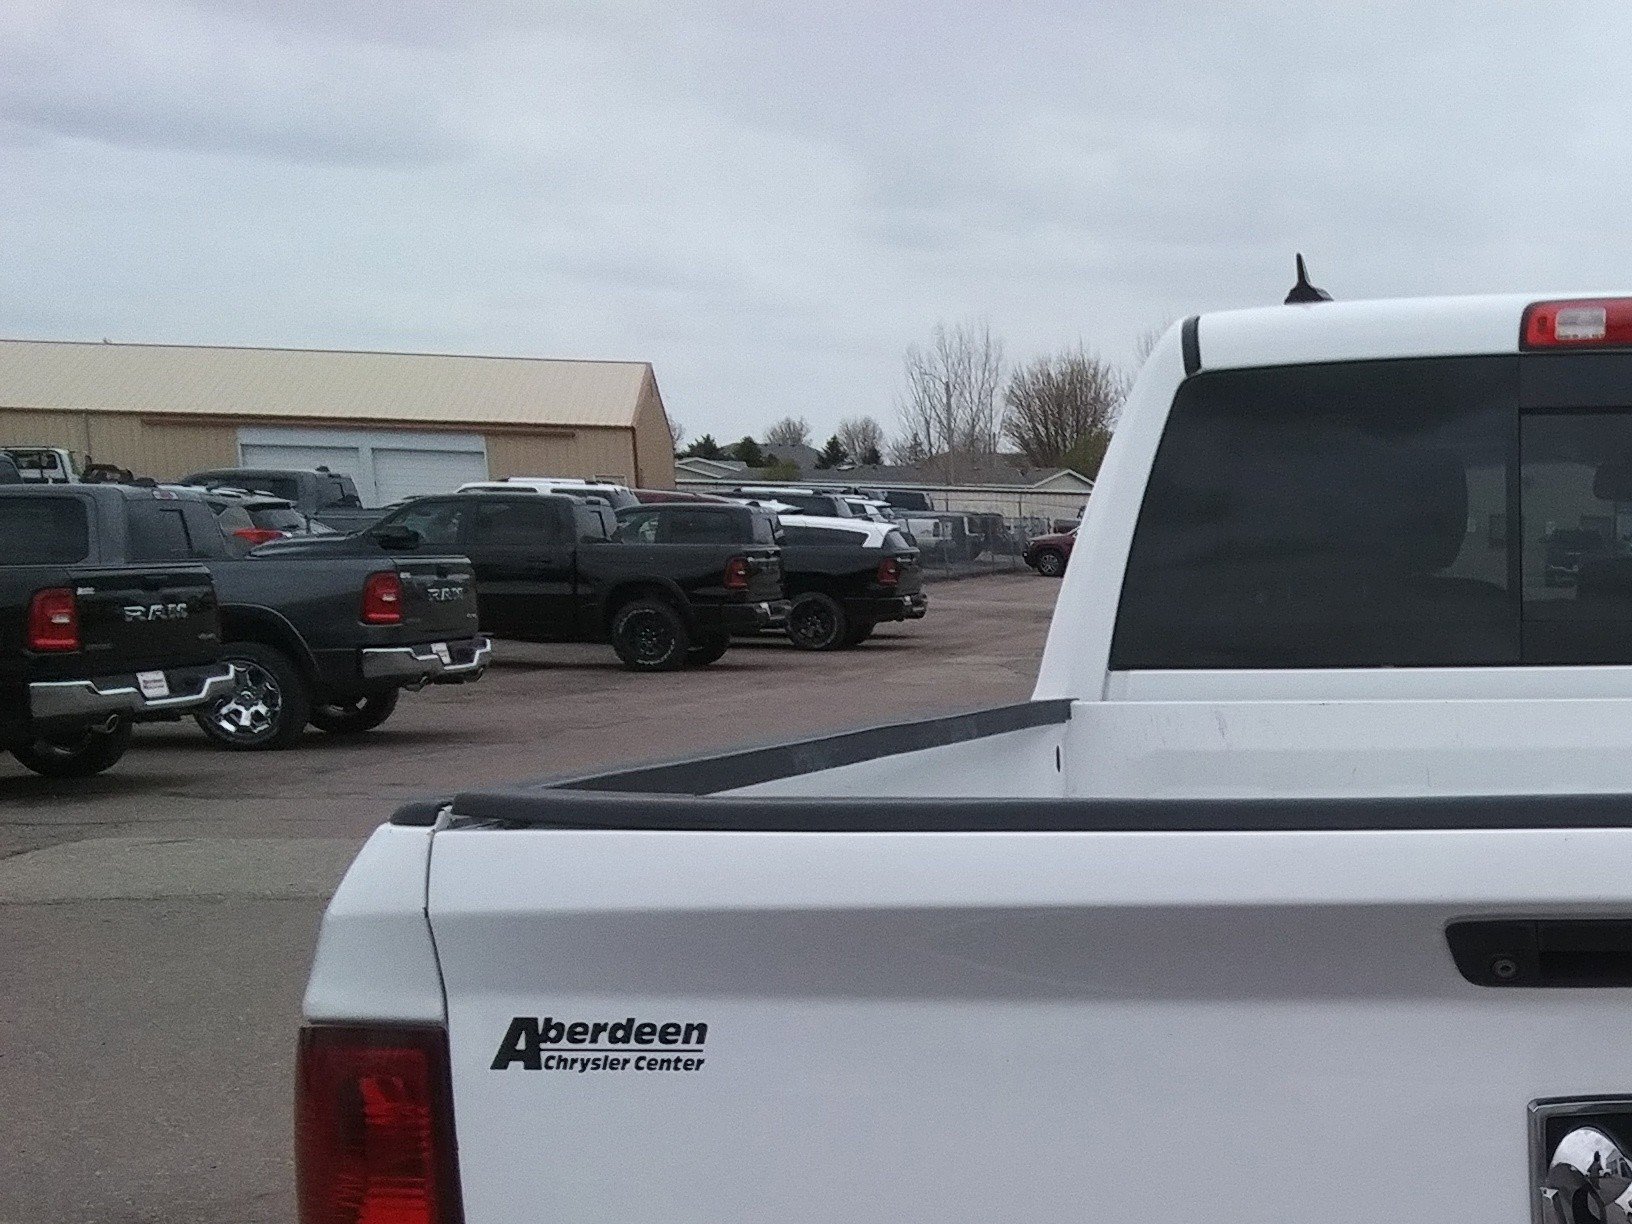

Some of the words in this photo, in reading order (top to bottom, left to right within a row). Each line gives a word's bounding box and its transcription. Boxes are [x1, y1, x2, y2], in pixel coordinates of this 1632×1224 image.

[123, 603, 188, 622] RAM
[490, 1016, 708, 1071] Aberdeen
[543, 1054, 630, 1073] Chrysler
[634, 1055, 705, 1072] Center
